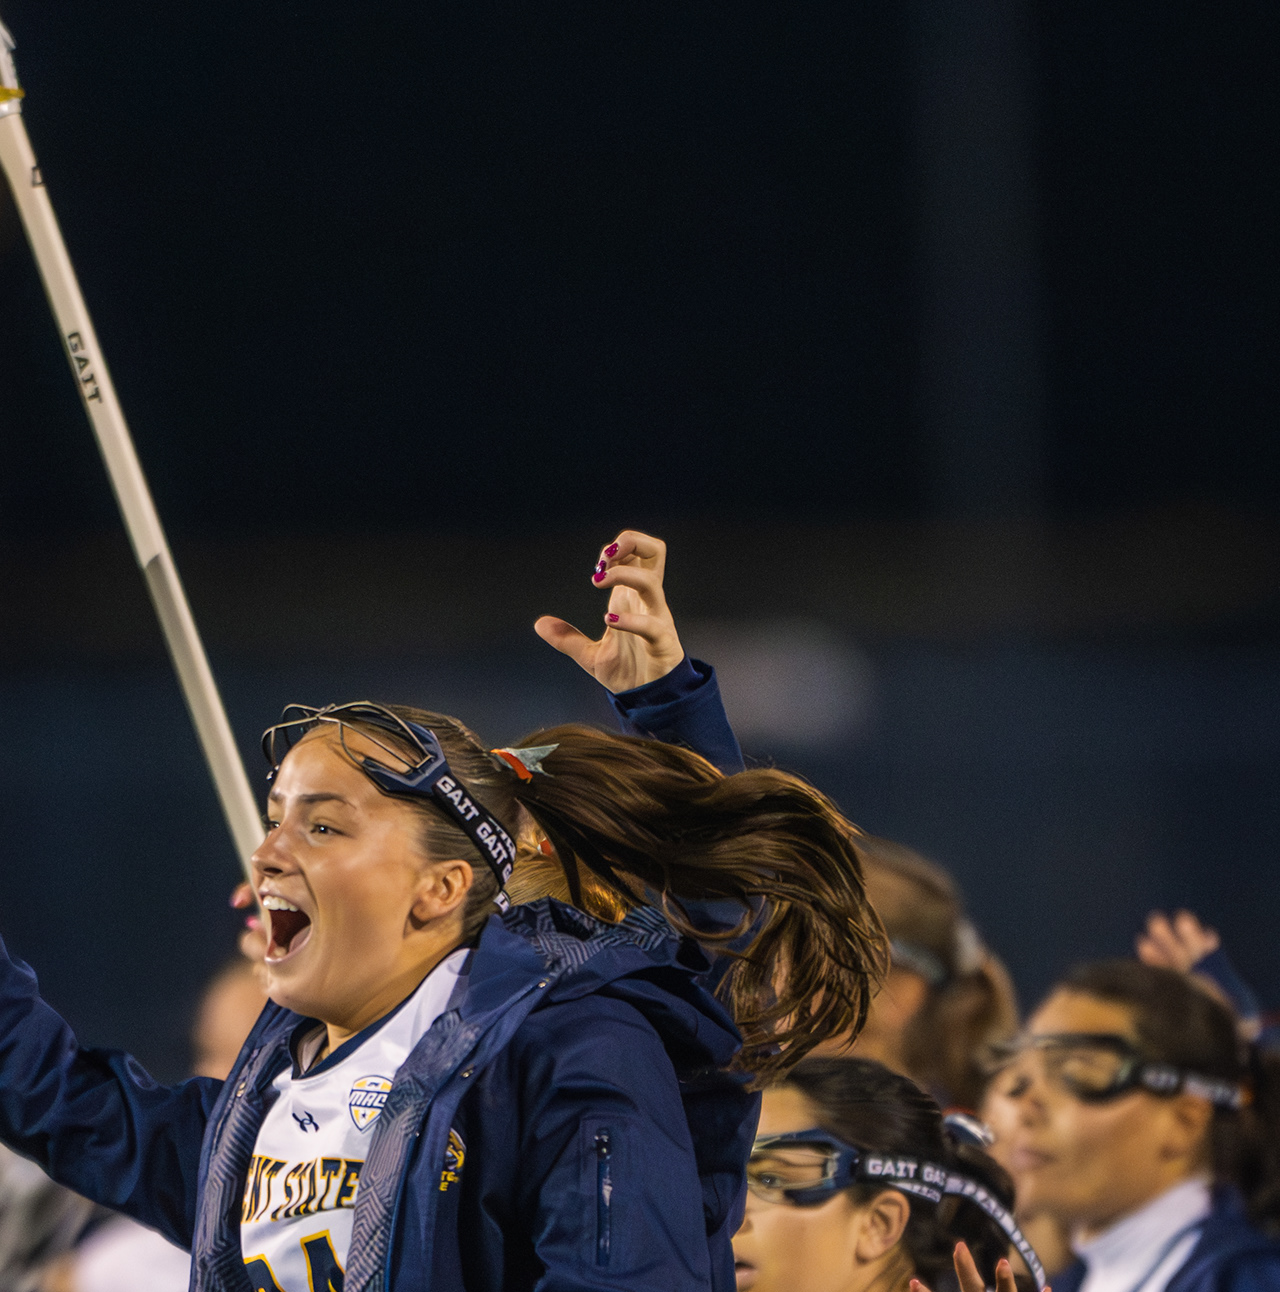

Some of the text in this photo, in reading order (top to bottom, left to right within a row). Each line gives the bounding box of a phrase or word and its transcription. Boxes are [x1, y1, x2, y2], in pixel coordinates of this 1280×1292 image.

[66, 332, 104, 406] GAIT
[435, 774, 480, 822] GAIT
[475, 821, 508, 866] GAIT
[349, 1090, 389, 1108] MAC
[270, 1156, 366, 1222] STATE
[867, 1157, 918, 1178] GAIT
